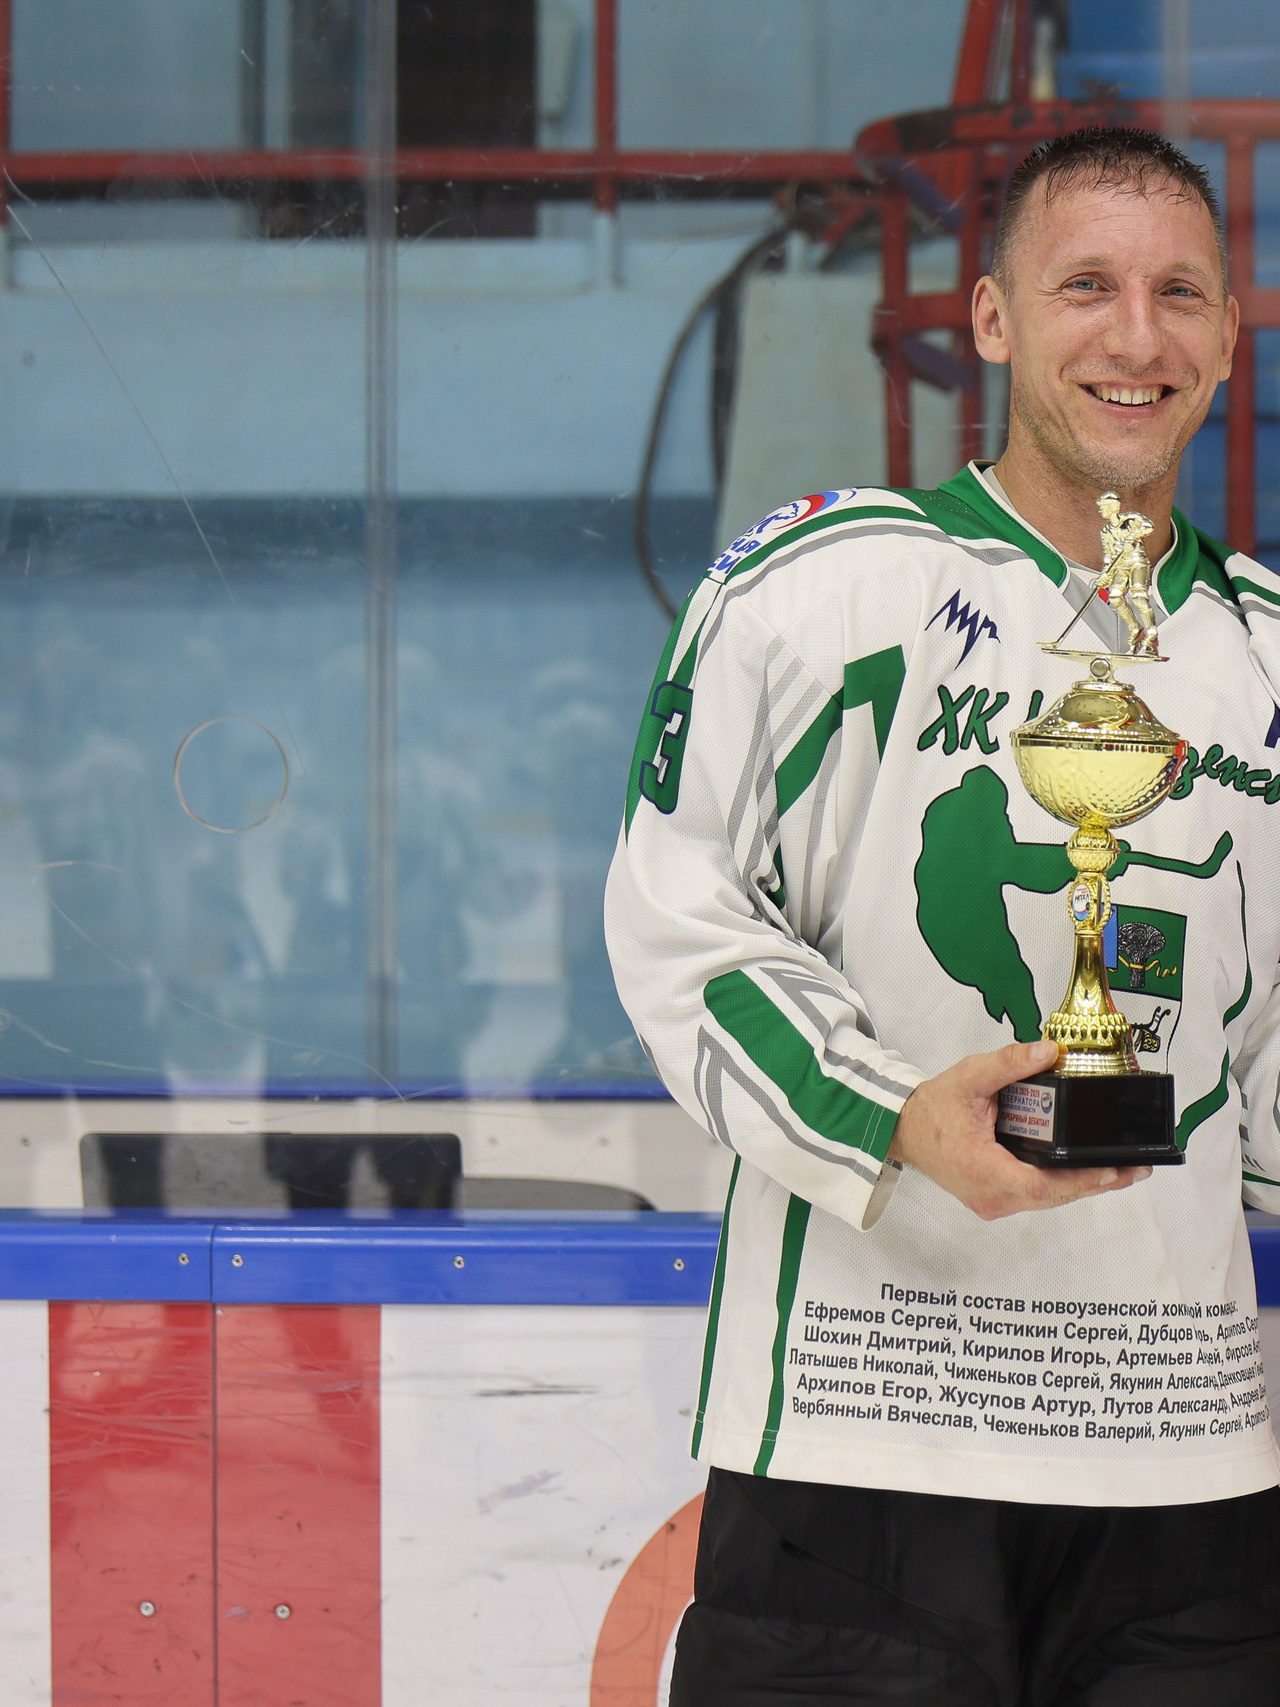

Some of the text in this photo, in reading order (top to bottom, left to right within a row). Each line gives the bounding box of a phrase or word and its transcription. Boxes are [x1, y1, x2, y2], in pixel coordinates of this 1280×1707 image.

[917, 684, 1009, 756] ХК
[1002, 1094, 1041, 1107] УБЕРНАТОРА
[804, 1301, 886, 1323] Ефремов
[891, 1309, 962, 1334] Сергей,
[969, 1316, 1058, 1339] Чистикин
[1064, 1322, 1133, 1344] Сергей,
[1137, 1324, 1193, 1345] Дубцов
[880, 1283, 957, 1306] Первый
[962, 1295, 1026, 1313] состав
[1031, 1299, 1157, 1319] новоузенской
[804, 1325, 862, 1346] Шохин
[866, 1330, 956, 1357] Дмитрий,
[962, 1339, 1045, 1363] Кирилов
[1051, 1346, 1111, 1368] Игорь,
[1116, 1349, 1193, 1369] Артемьев
[789, 1348, 858, 1370] Латышев
[863, 1354, 939, 1380] Николай,
[944, 1361, 1037, 1387] Чиженьков
[1042, 1370, 1105, 1392] Сергей,
[1109, 1373, 1163, 1394] Якунин
[796, 1373, 876, 1395] Архипов
[882, 1380, 933, 1403] Егор,
[939, 1384, 1026, 1410] Жусупов
[1031, 1394, 1096, 1417] Артур,
[1102, 1397, 1153, 1418] Лутов
[792, 1396, 882, 1420] Вербянный
[887, 1405, 977, 1432] Вячеслав,
[983, 1414, 1079, 1437] Чеженьков
[1084, 1421, 1155, 1443] Валерий,
[1159, 1421, 1206, 1441] Якунин
